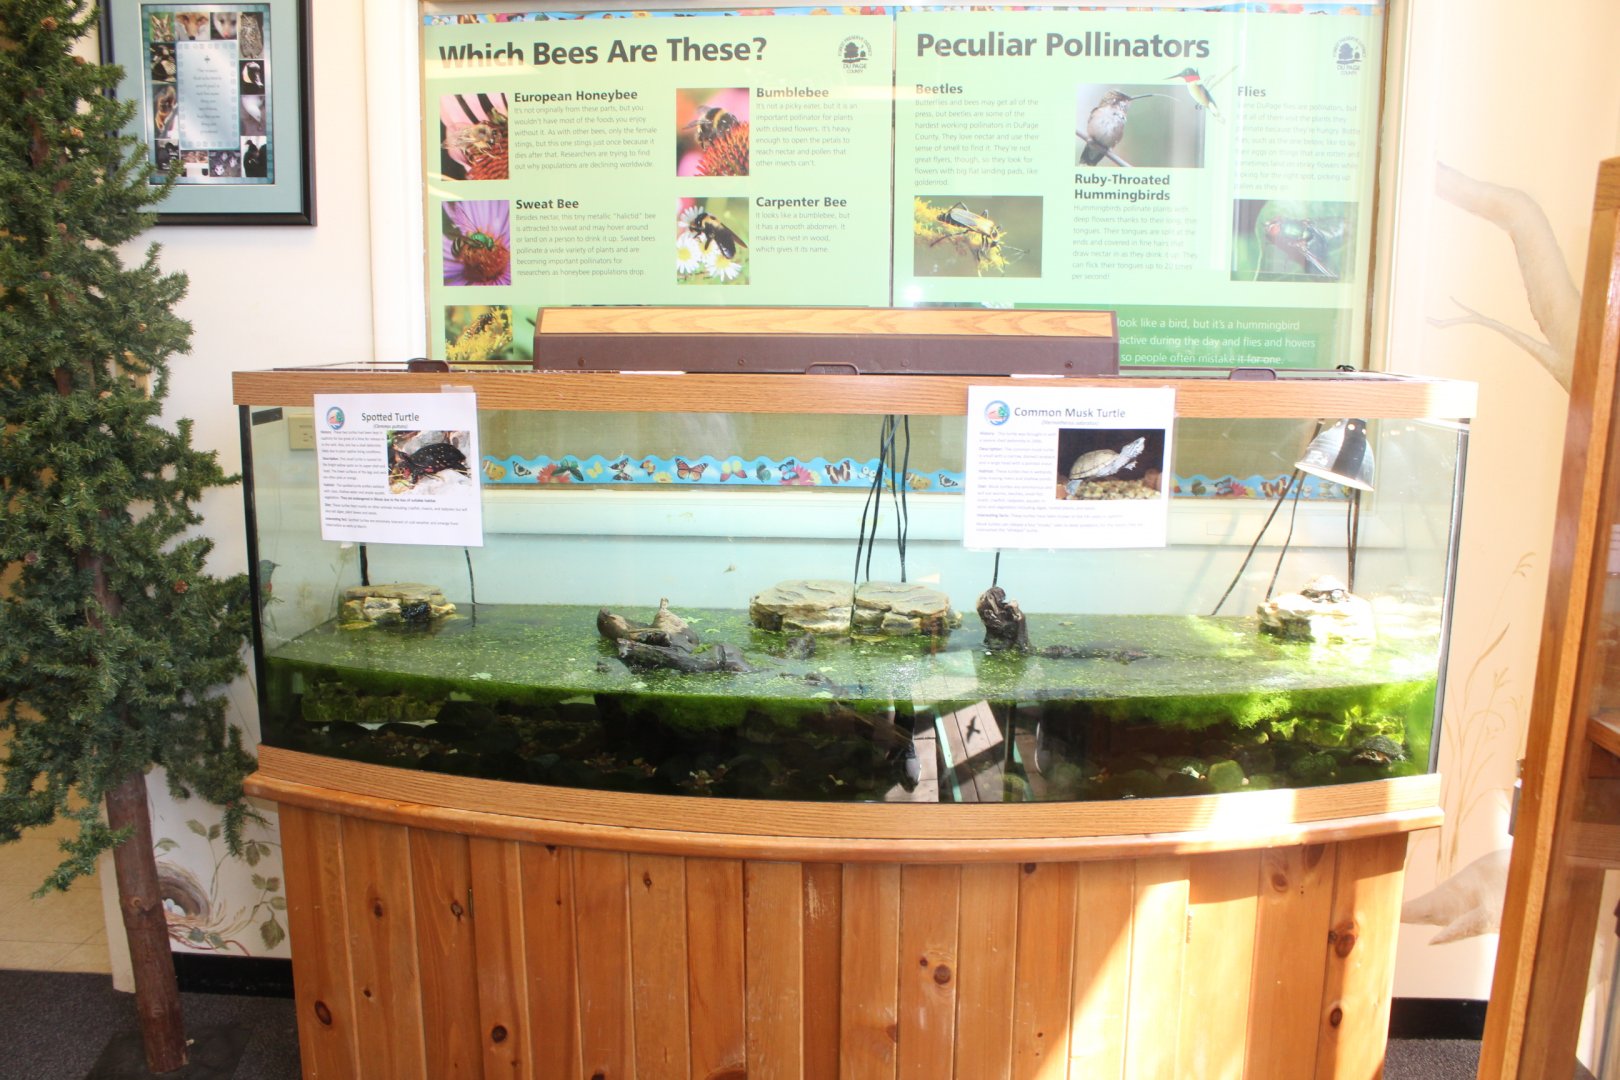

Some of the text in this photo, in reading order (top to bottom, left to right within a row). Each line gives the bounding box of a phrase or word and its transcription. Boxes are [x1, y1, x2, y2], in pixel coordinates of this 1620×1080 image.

[917, 32, 1210, 59] Peculiar Pollinators
[439, 37, 766, 69] Which Bees Are These?
[756, 87, 829, 97] Bumblebee
[916, 83, 963, 94] Beetles
[1238, 86, 1266, 97] Flies
[515, 90, 637, 104] European Honeybee
[536, 106, 563, 115] originally
[600, 104, 617, 113] parts,
[1075, 174, 1170, 187] Ruby-Throated
[1075, 189, 1170, 202] Hummingbirds
[516, 199, 579, 209] Sweat Bee
[756, 197, 847, 209] Carpenter Bee
[1118, 318, 1137, 328] look
[1141, 319, 1157, 328] like
[1169, 319, 1190, 329] bird,
[1193, 319, 1209, 329] but
[1212, 319, 1225, 329] it's
[1237, 320, 1299, 332] hummingbird
[1120, 336, 1315, 348] active during the day and flies and hovers
[1135, 353, 1167, 365] people
[1170, 353, 1195, 363] often
[1198, 353, 1234, 363] mistake
[1237, 355, 1244, 363] it
[1247, 355, 1262, 364] for
[361, 413, 419, 424] Spotted Turtle
[1014, 407, 1125, 418] Common Musk Turtle
